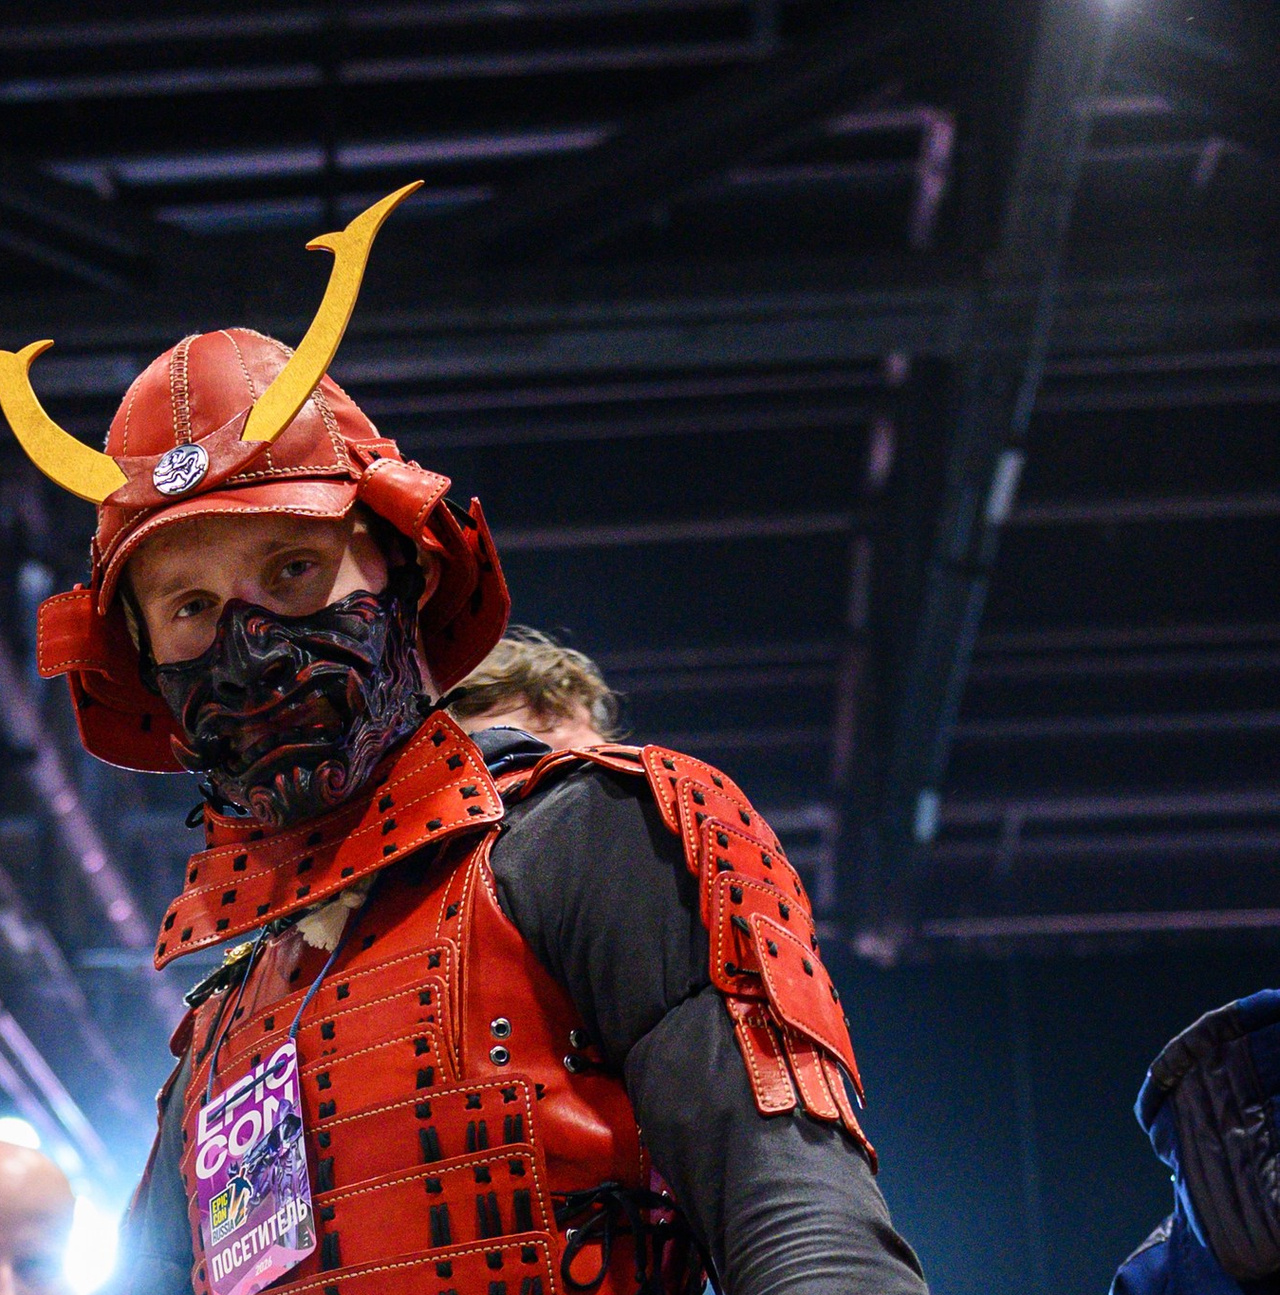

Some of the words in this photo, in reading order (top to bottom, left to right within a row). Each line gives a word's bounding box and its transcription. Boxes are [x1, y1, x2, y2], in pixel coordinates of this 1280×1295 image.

[197, 1043, 297, 1146] EPIC
[195, 1080, 294, 1180] CON
[212, 1192, 228, 1213] EPIC
[212, 1208, 228, 1227] CON
[212, 1218, 235, 1243] RUSSIA
[212, 1198, 308, 1282] ПОСЕТИТЕЛЬ
